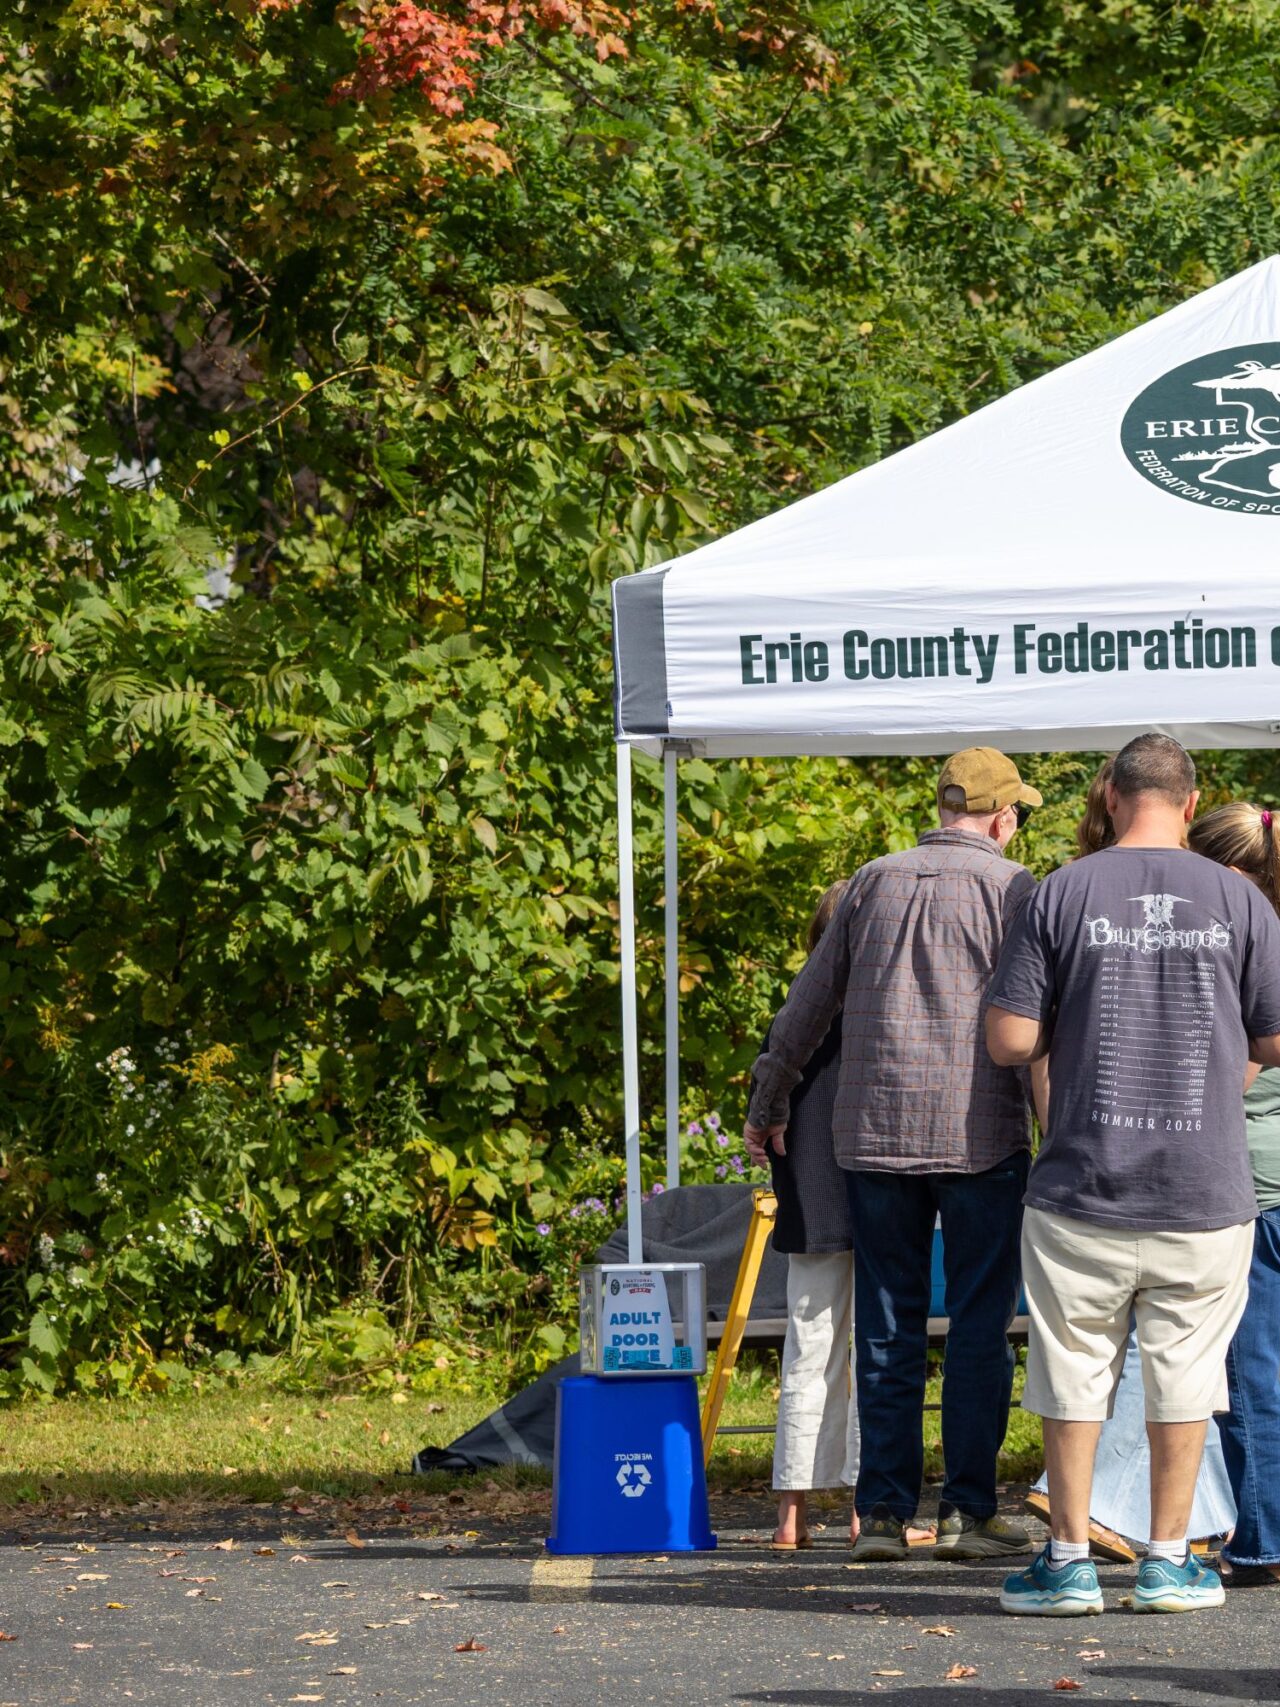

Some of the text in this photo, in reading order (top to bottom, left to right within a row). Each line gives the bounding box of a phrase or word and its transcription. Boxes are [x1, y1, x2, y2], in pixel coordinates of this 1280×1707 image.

[1144, 417, 1240, 440] ERIE
[1135, 448, 1208, 501] FEDERATION
[1211, 494, 1241, 509] OF
[739, 631, 830, 686] Erie
[842, 626, 1000, 685] County
[1012, 618, 1258, 676] Federation
[1091, 1110, 1202, 1131] SUMMER 2026
[609, 1311, 662, 1326] ADULT
[611, 1332, 659, 1347] DOOR
[614, 1452, 653, 1461] WE RECYCLE
